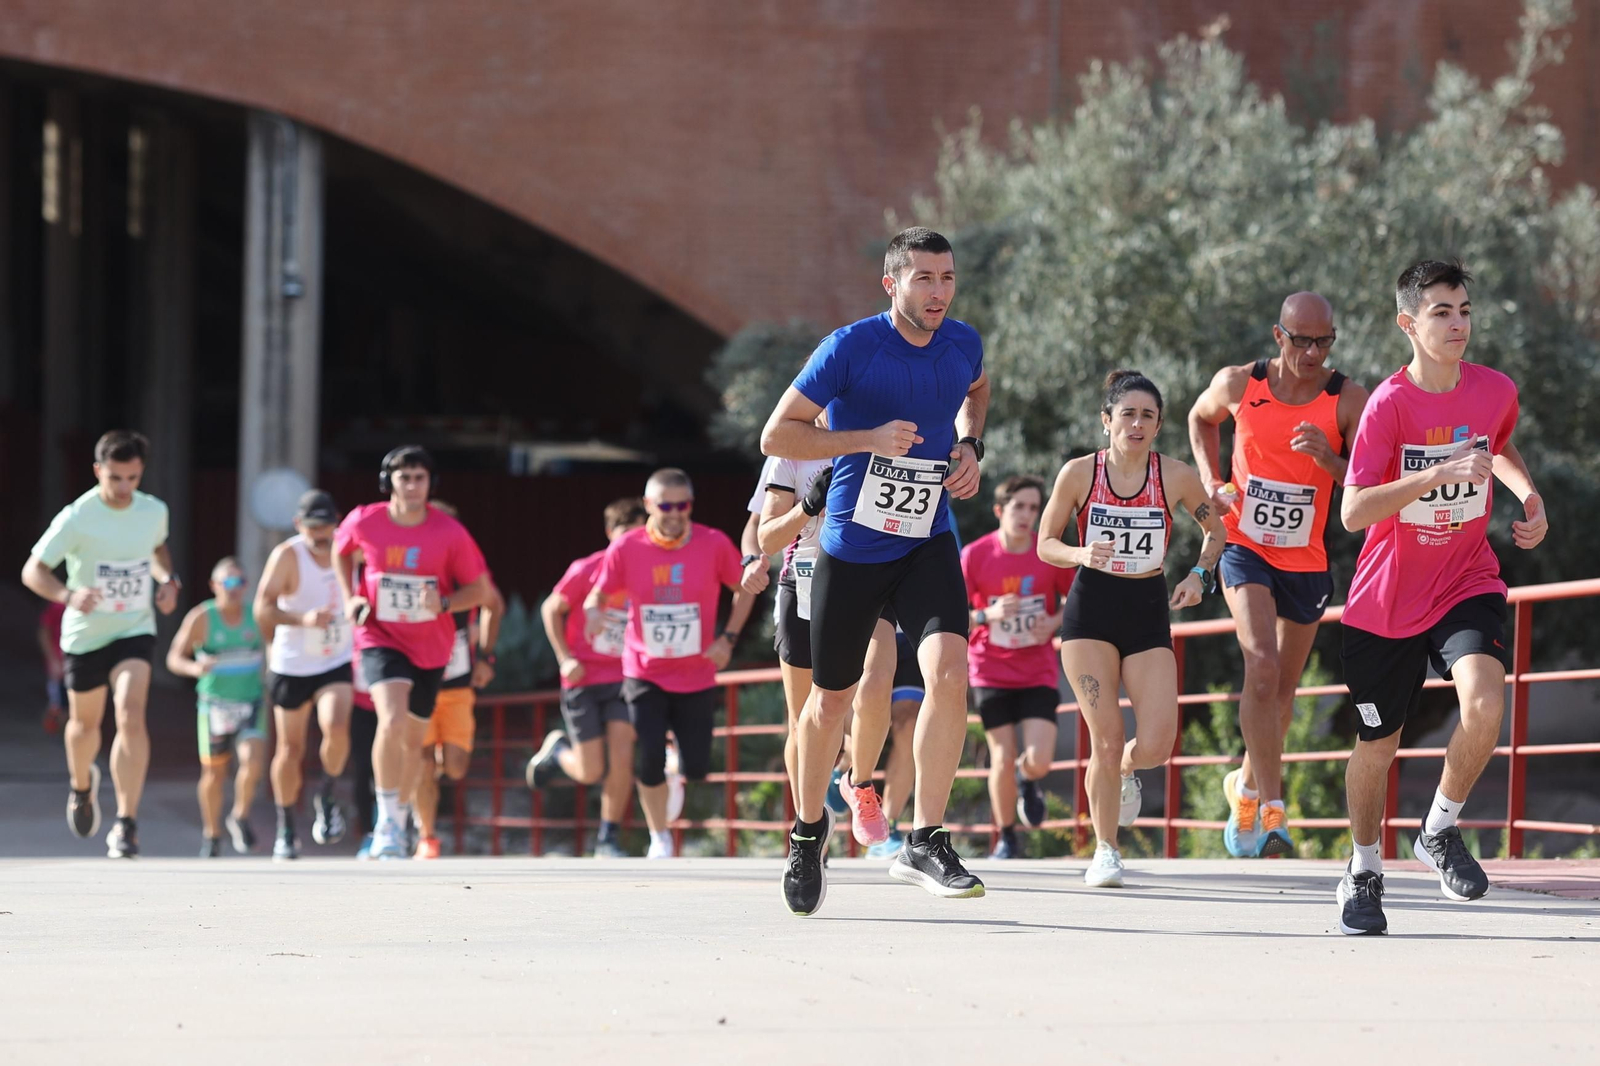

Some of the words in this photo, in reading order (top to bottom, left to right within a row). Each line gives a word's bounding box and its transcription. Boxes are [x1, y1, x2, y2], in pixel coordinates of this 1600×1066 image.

[873, 464, 910, 481] UMA
[874, 482, 932, 515] 323
[1249, 486, 1280, 502] UMA
[884, 520, 901, 530] WE
[1092, 514, 1126, 527] UMA
[1253, 503, 1304, 530] 659
[1435, 511, 1451, 521] WE
[386, 546, 421, 569] WE
[652, 563, 684, 586] WE
[106, 579, 142, 599] 502
[390, 591, 420, 610] 13
[652, 623, 691, 643] 677
